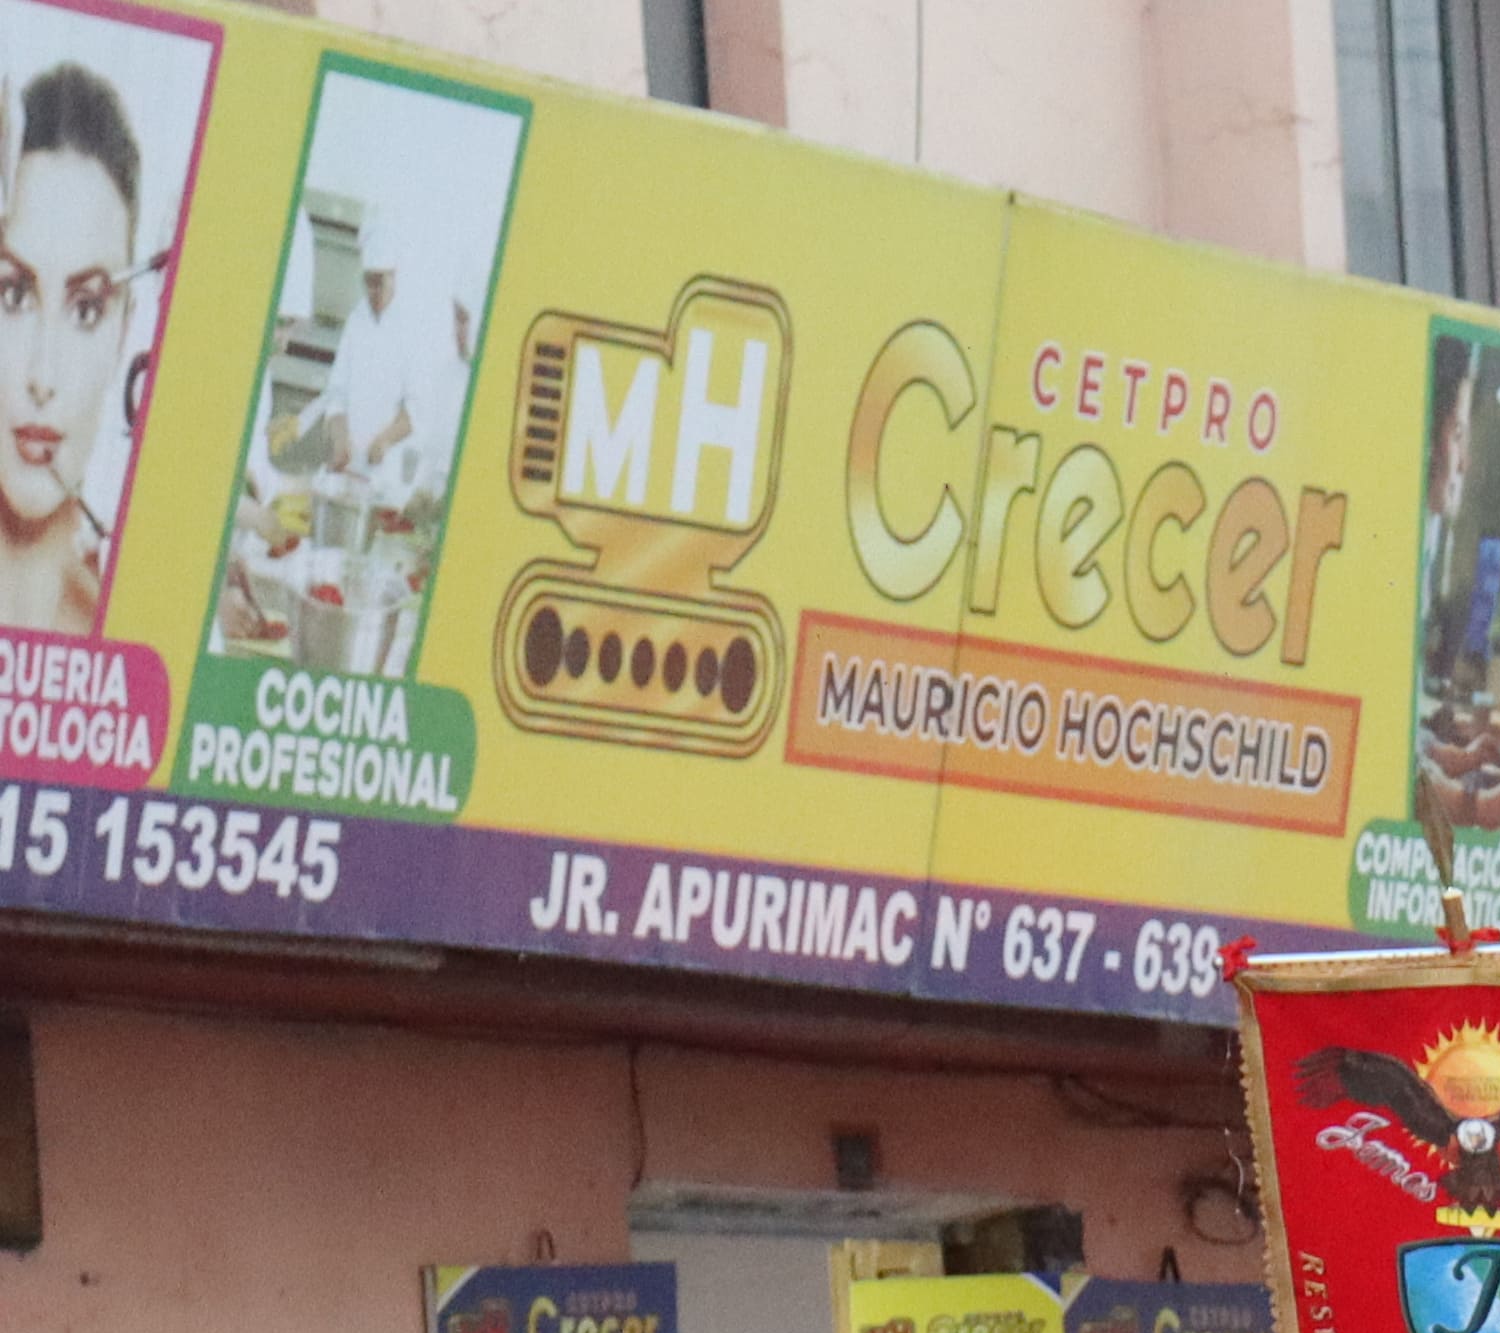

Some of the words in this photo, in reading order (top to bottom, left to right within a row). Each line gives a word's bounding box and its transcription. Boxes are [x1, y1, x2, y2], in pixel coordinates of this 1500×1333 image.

[561, 328, 767, 524] MH
[1031, 342, 1278, 453] CETPRO
[845, 319, 1348, 668] Crecer
[189, 723, 457, 811] PROFESIONAL
[256, 668, 408, 743] COCINA
[820, 655, 1047, 753] MAURICIO
[1057, 689, 1330, 791] HOCHSCHILD
[97, 797, 342, 901] 153545
[530, 852, 619, 935] JR.
[634, 862, 917, 966] APURIMAC
[1003, 905, 1095, 983] 637
[1134, 918, 1219, 997] 639
